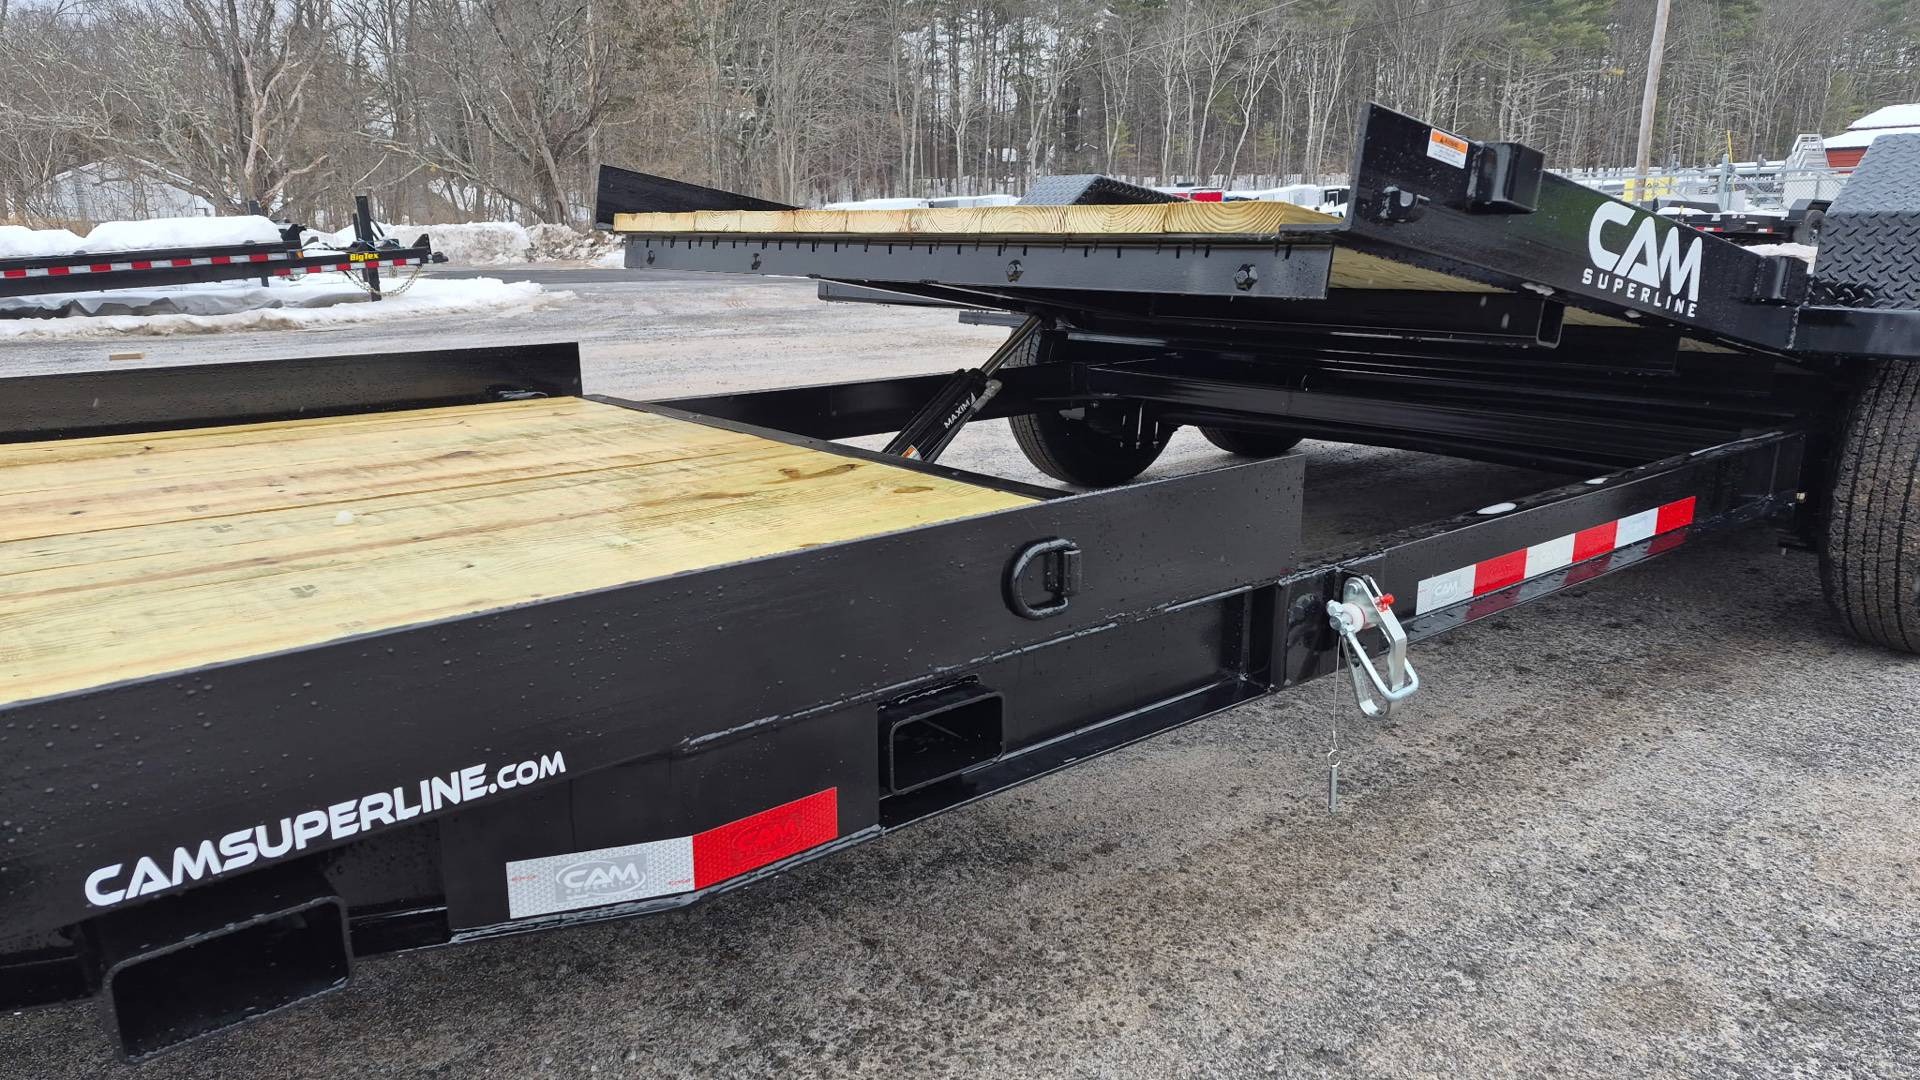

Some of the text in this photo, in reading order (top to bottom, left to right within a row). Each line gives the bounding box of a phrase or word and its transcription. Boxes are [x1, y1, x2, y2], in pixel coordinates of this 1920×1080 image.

[1588, 200, 1703, 302] CAM
[1581, 268, 1698, 318] SUPERLINE
[84, 750, 567, 907] CAMSUPERLINE.COM
[563, 862, 640, 889] CAM
